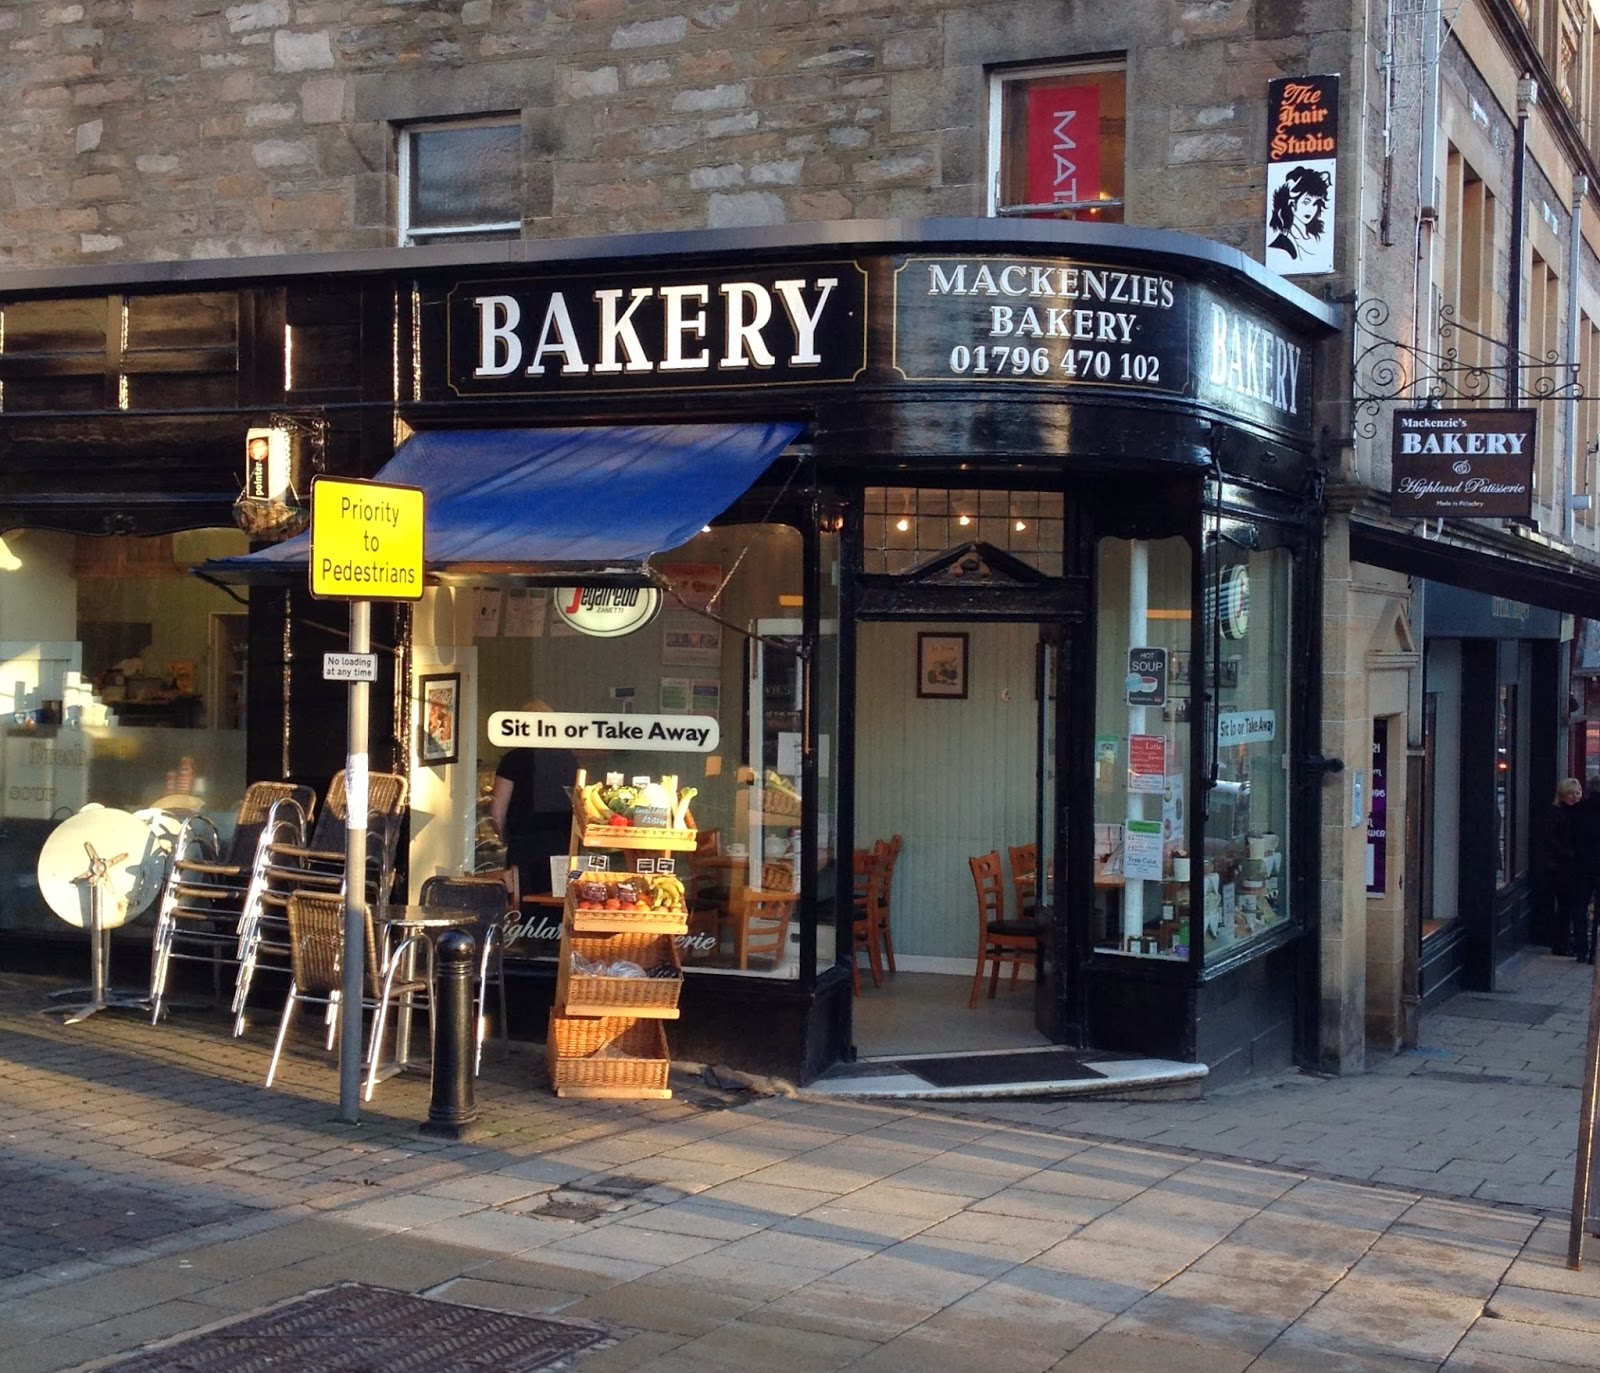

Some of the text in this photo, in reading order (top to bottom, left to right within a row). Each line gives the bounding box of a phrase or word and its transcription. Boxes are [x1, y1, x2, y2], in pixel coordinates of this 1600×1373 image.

[1281, 83, 1322, 105] The
[1270, 132, 1335, 160] Studio
[1052, 110, 1077, 213] MAT
[927, 264, 1175, 310] MACKENZIE'S
[473, 278, 839, 379] BAKERY
[988, 305, 1138, 344] BAKERY
[949, 345, 1160, 383] 01796 470 102
[1210, 303, 1302, 415] BAKERY
[1401, 418, 1467, 428] Mackenzie's
[1401, 432, 1527, 455] BAKERY
[253, 461, 264, 496] pointer
[1452, 459, 1471, 475] &
[1398, 476, 1526, 500] Highland Patisserie
[341, 496, 400, 528] Priority
[363, 530, 380, 552] to
[322, 558, 415, 584] Pedestrians
[326, 668, 372, 678] at any time
[327, 656, 372, 668] No loading
[1131, 661, 1163, 672] SOUP
[501, 719, 711, 746] Sit In or Take Away
[1220, 717, 1274, 737] Sit In or Take Away
[502, 910, 716, 950] ighla erie
